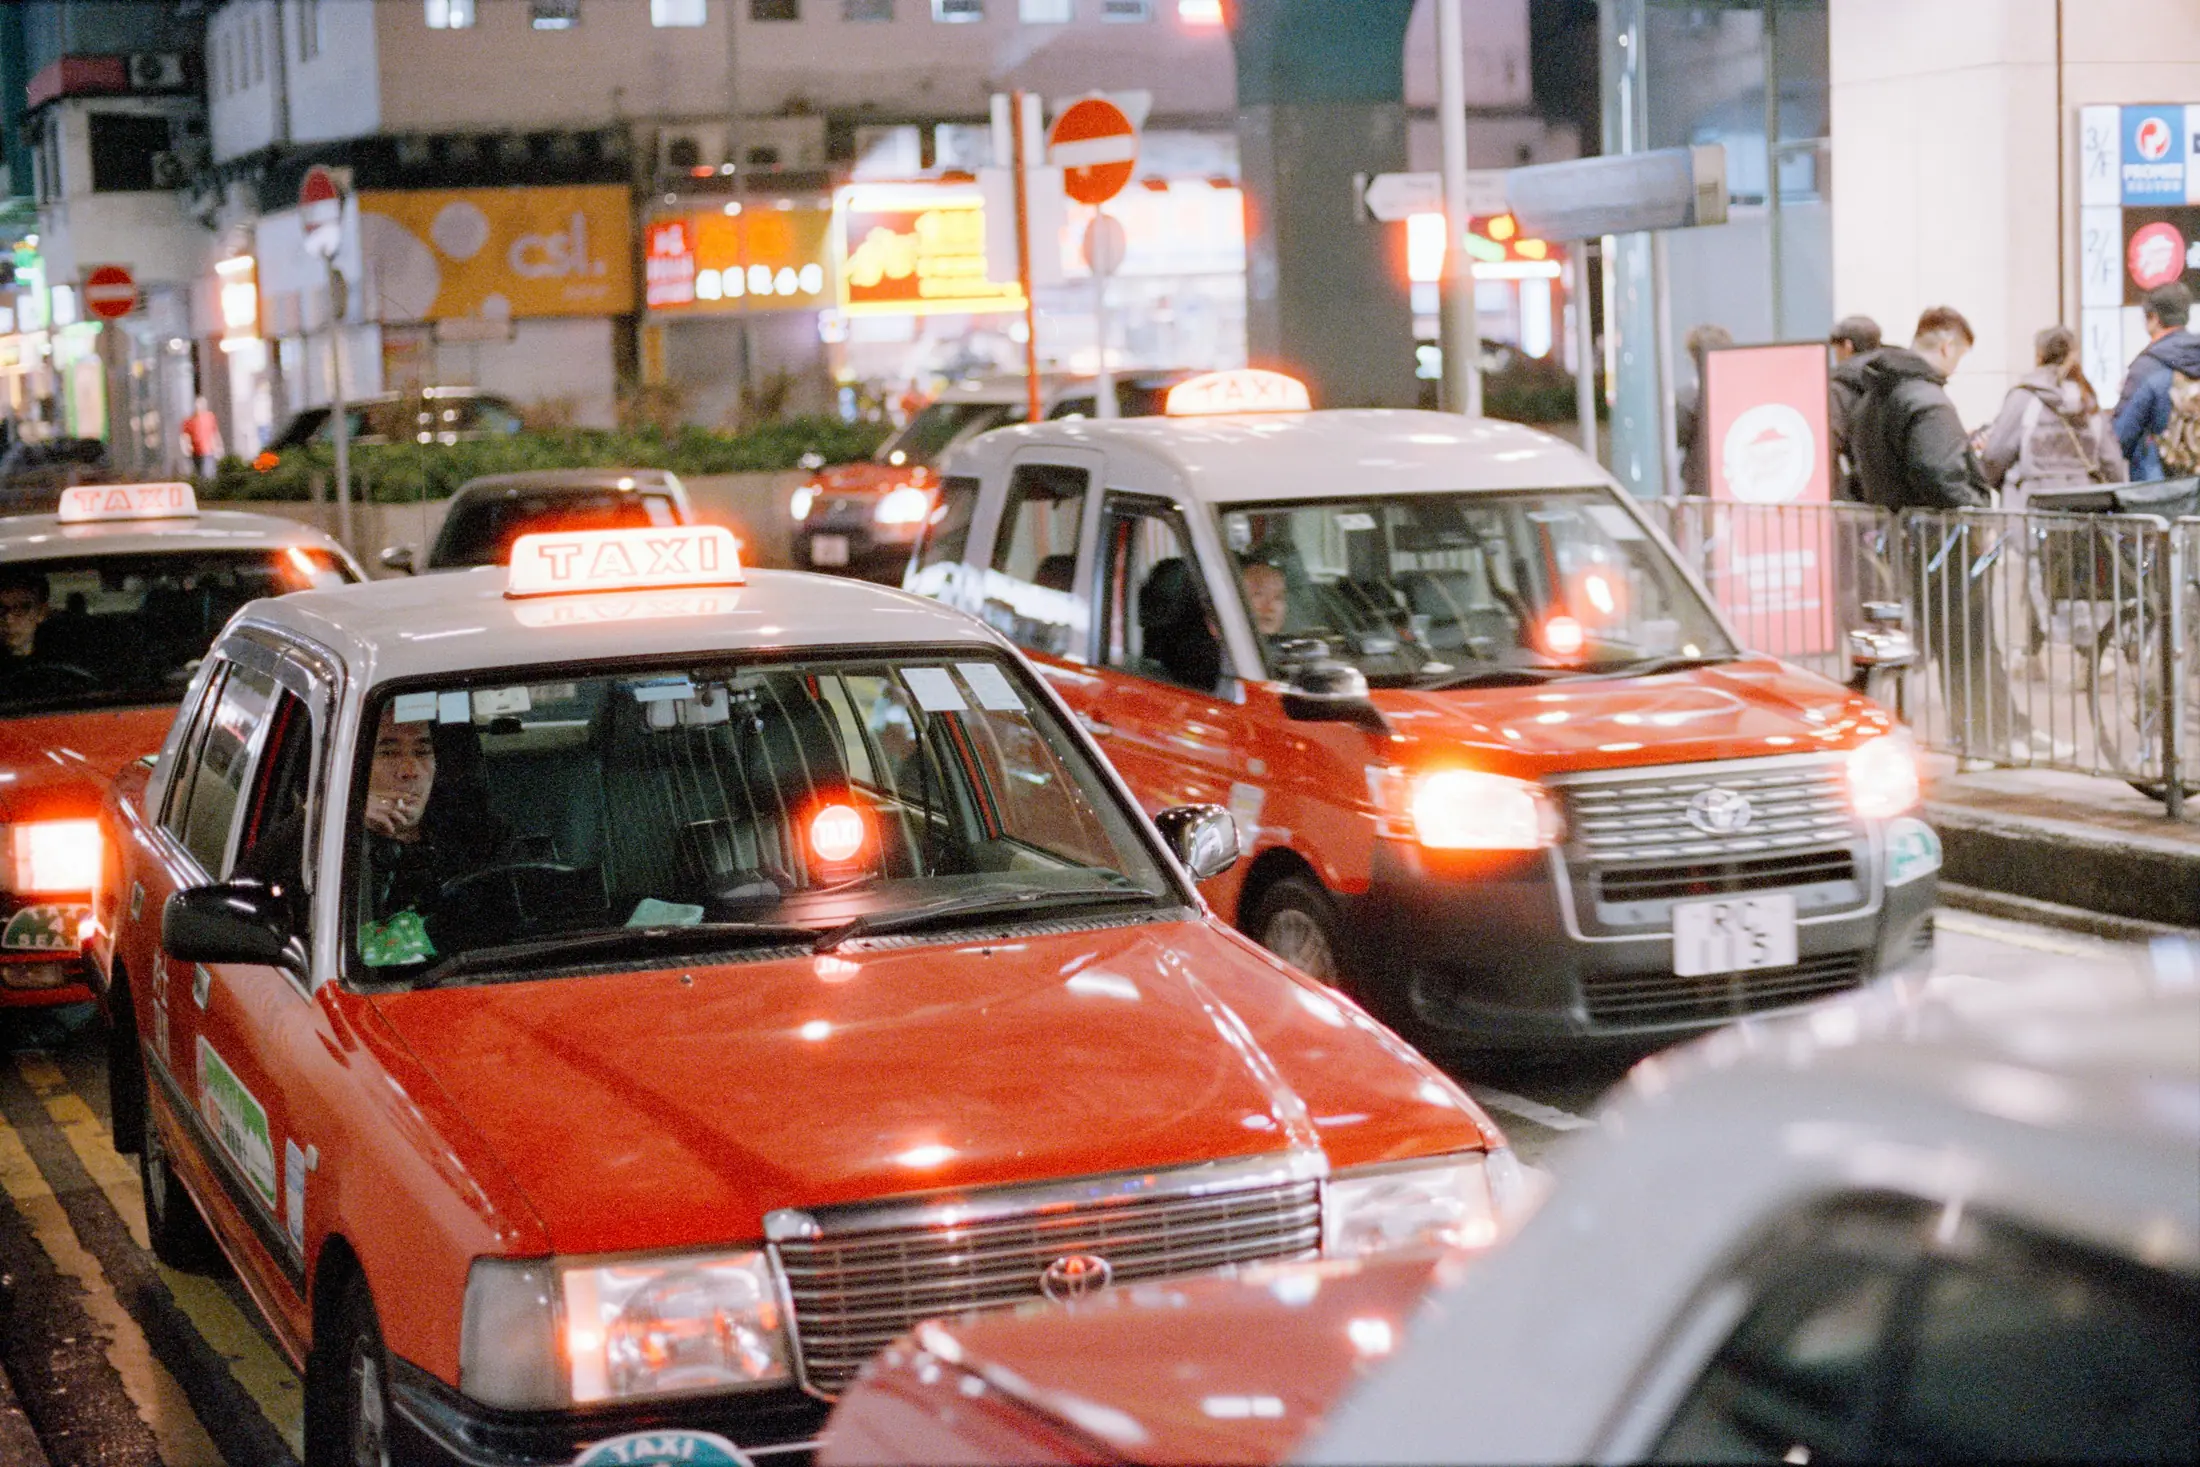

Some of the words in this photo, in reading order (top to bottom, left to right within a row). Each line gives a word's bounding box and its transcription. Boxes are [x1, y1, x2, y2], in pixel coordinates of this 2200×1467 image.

[1196, 378, 1288, 403] TAXI
[73, 486, 183, 512] TAXI
[538, 535, 718, 581] TAXI
[814, 819, 858, 850] TAXI
[609, 1435, 695, 1464] TAXI
